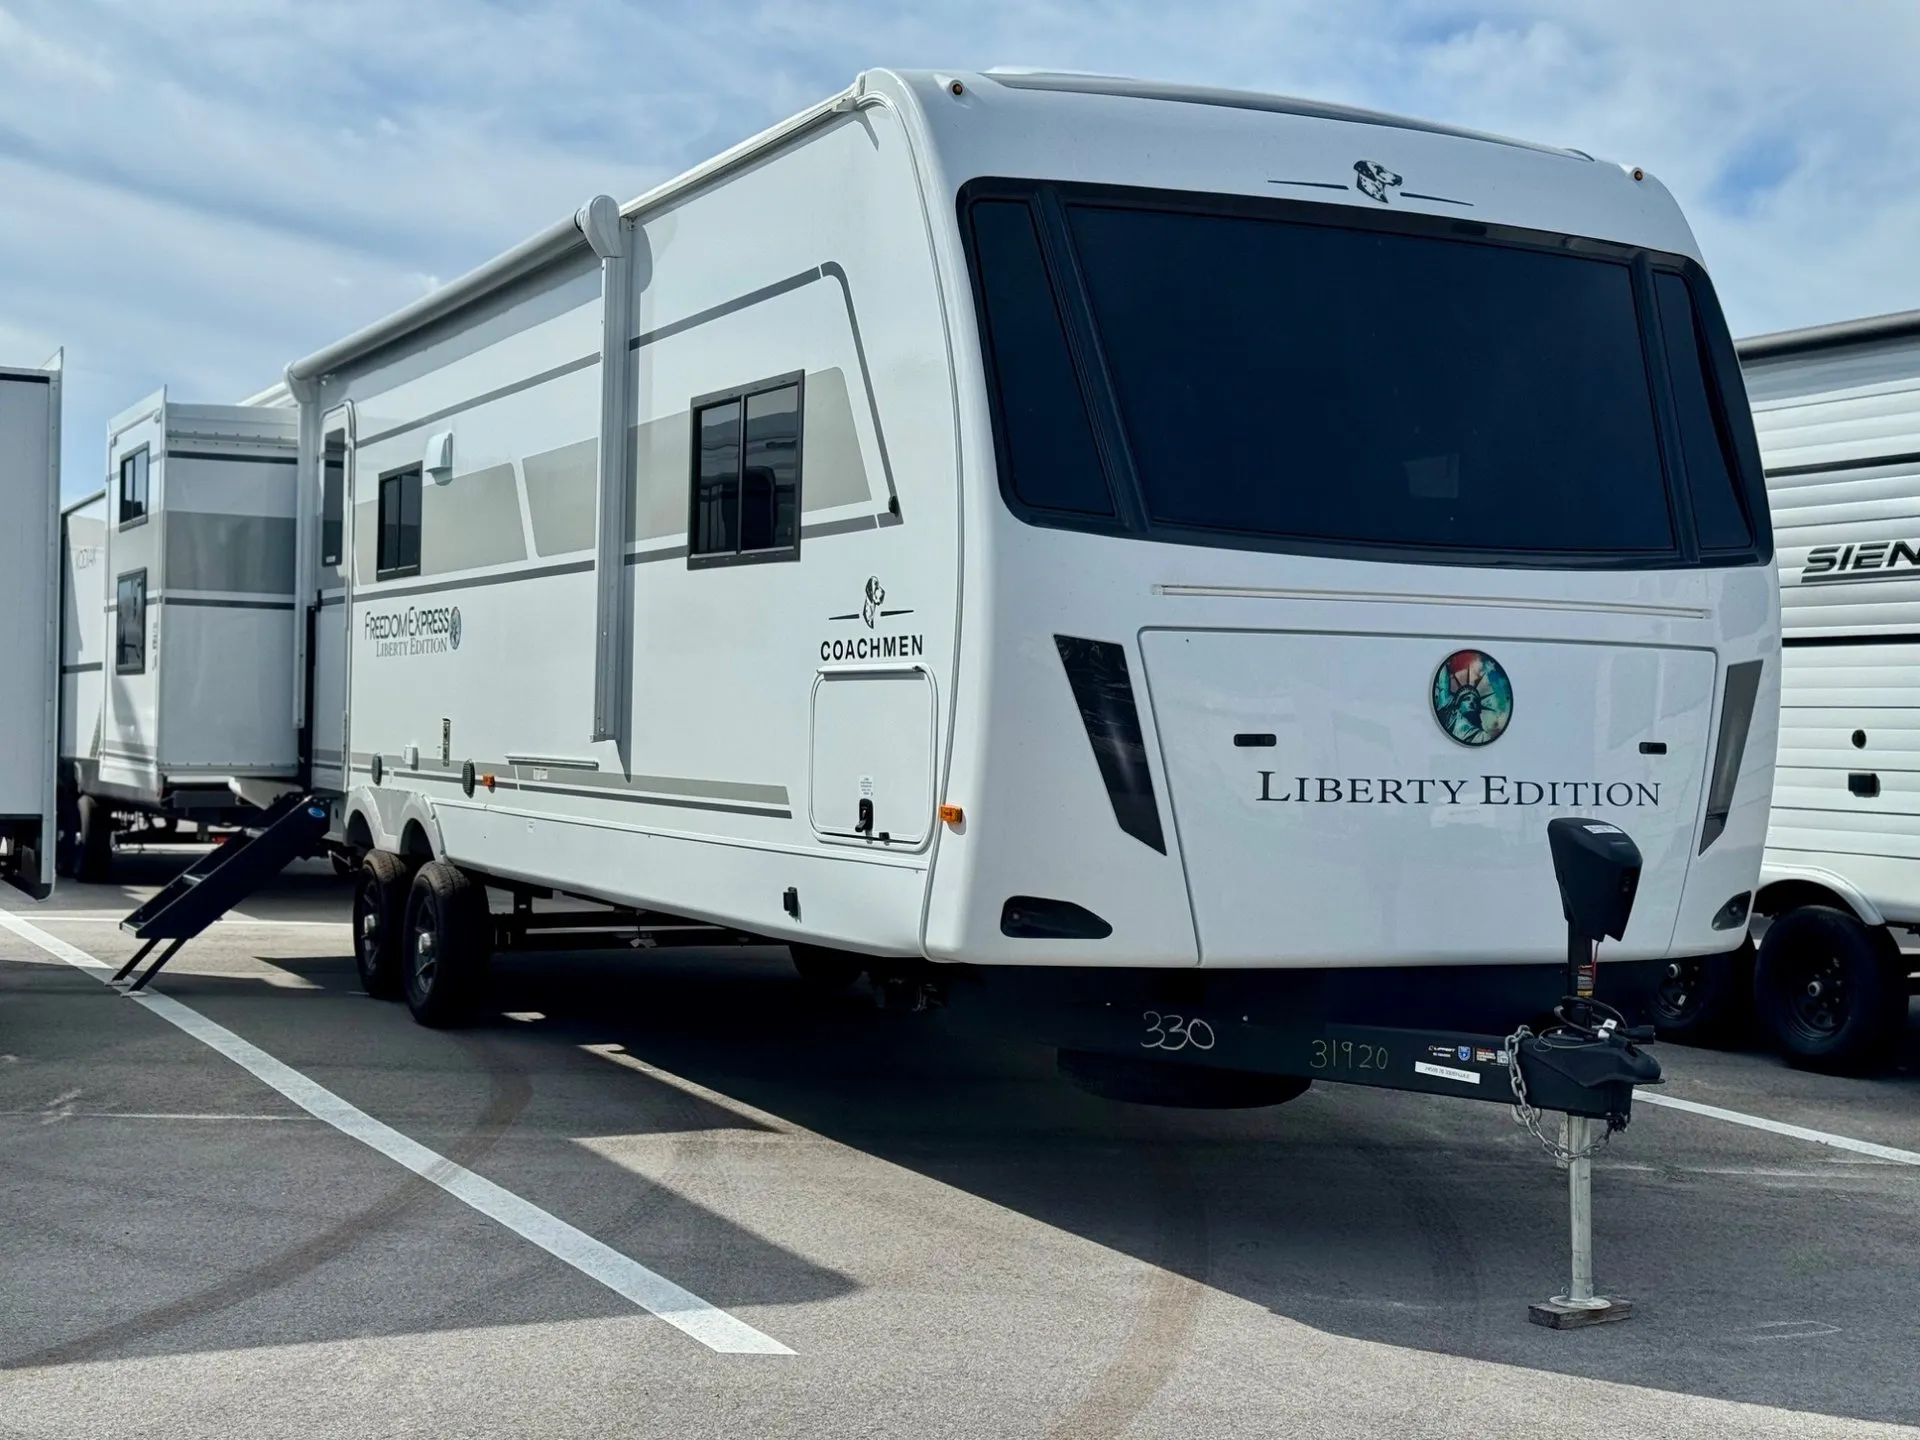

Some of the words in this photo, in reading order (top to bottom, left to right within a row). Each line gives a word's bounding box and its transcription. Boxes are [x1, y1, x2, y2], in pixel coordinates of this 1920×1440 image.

[376, 639, 408, 657] LIBERTY
[410, 637, 447, 655] EDITION
[820, 634, 923, 661] COACHMEN
[1256, 770, 1468, 805] LIBERTY
[1480, 775, 1662, 807] EDITION
[1140, 1011, 1215, 1050] 330
[1310, 1040, 1389, 1070] 31920
